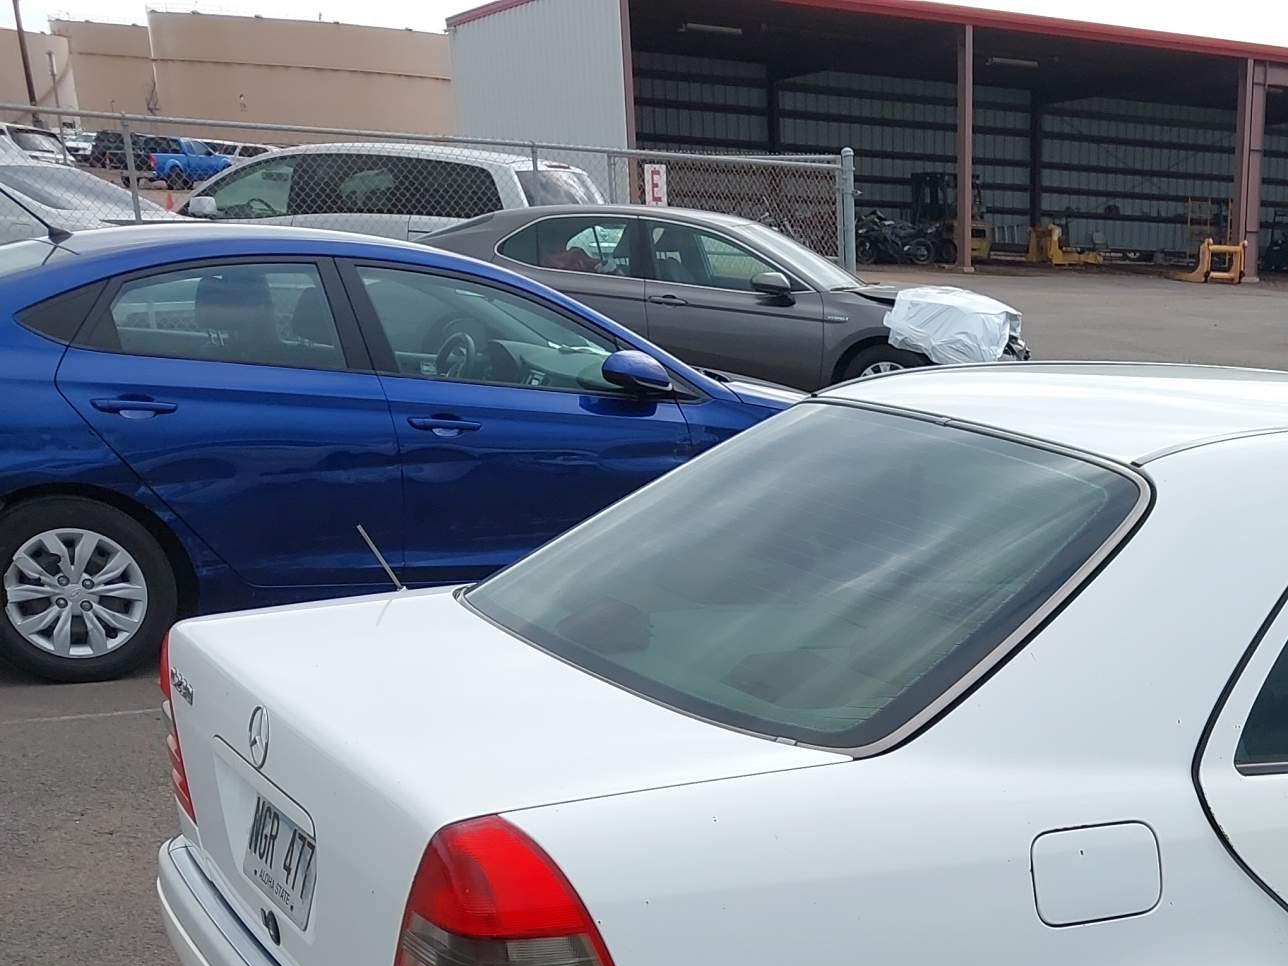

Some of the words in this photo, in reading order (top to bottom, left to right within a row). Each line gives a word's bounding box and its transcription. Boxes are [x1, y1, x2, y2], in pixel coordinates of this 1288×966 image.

[651, 170, 663, 202] E
[248, 796, 280, 871] NGR
[283, 828, 316, 901] 477
[258, 869, 275, 890] ALOHA
[274, 883, 291, 906] STATE
